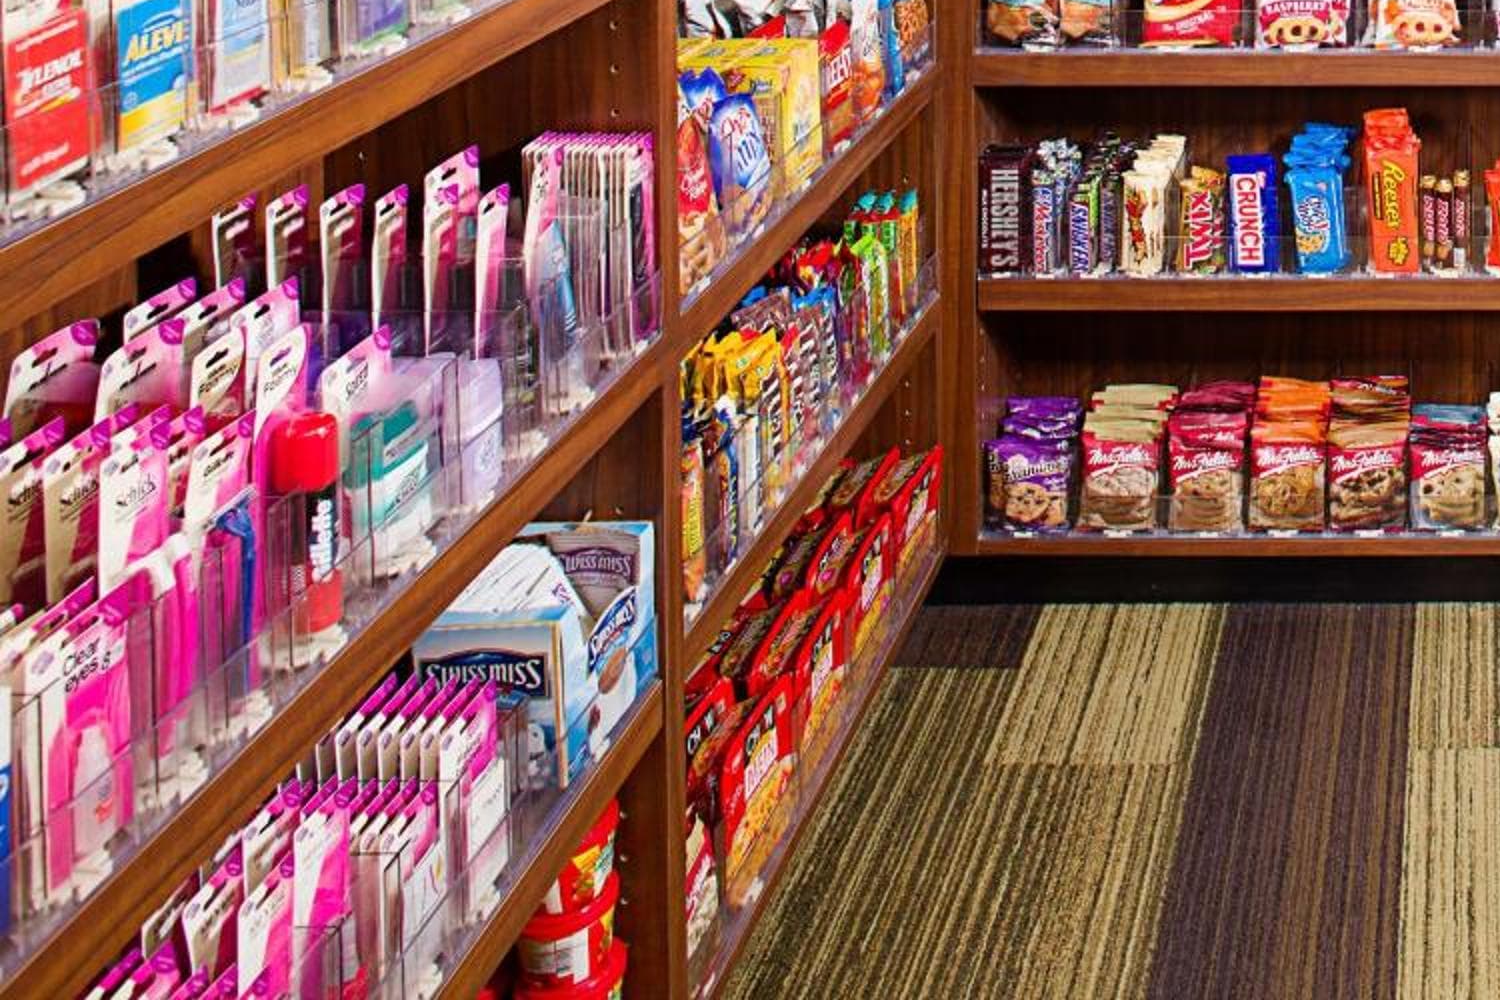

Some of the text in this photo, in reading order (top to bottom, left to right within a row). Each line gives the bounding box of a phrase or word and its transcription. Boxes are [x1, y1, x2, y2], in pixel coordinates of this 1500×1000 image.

[991, 168, 1019, 268] HERSHEY'S
[1235, 177, 1258, 263] CRUNCH
[1382, 159, 1407, 230] Reese's
[64, 637, 100, 677] Clear
[64, 656, 98, 693] eyes
